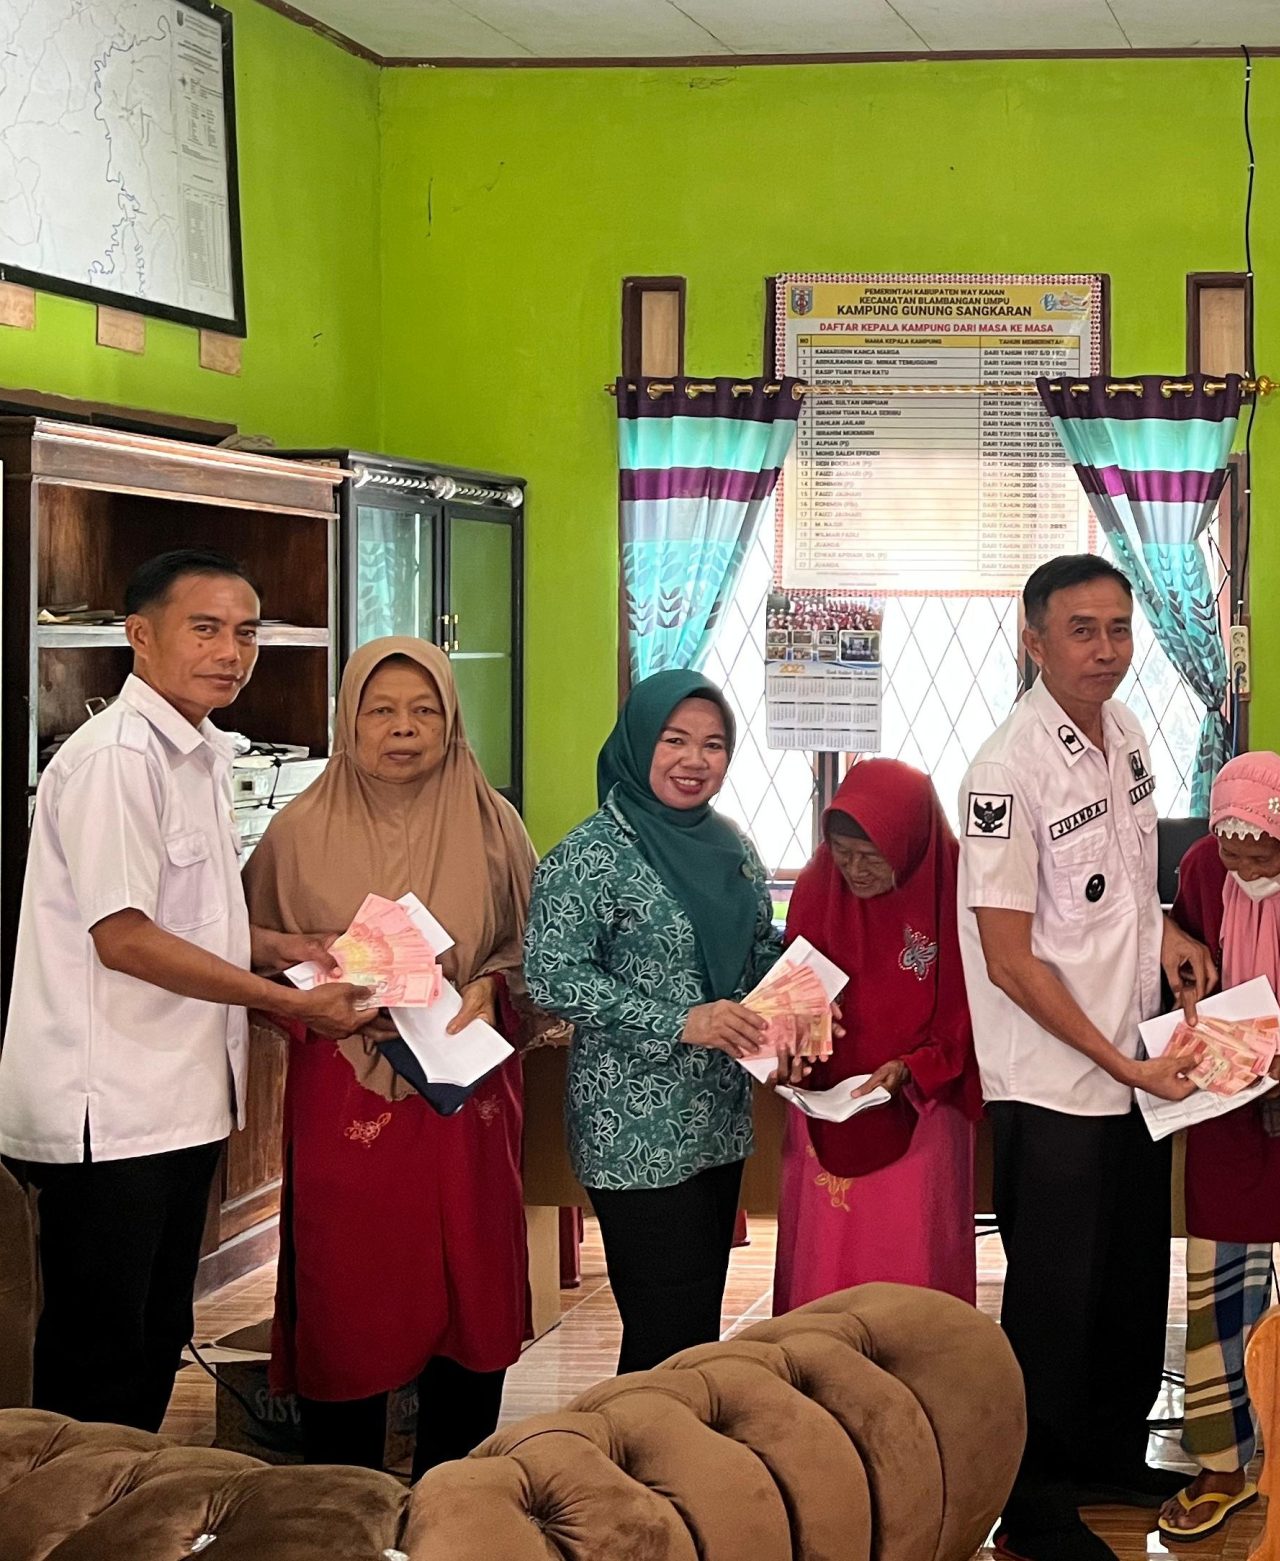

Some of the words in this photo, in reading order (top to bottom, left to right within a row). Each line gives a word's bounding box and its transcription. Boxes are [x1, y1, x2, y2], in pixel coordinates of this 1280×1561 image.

[917, 297, 980, 305] BLAMBANGAN
[837, 305, 898, 315] KAMPUNG
[902, 305, 953, 316] GUNUNG
[956, 306, 1032, 316] SANGKARAN
[820, 323, 858, 331] DAFTAR
[861, 323, 899, 331] KEPALA
[901, 323, 951, 332] KAMPUNG
[953, 324, 976, 332] DARI
[979, 324, 1007, 332] MASA
[1025, 324, 1053, 332] MASA
[1057, 805, 1102, 834] JUANDA
